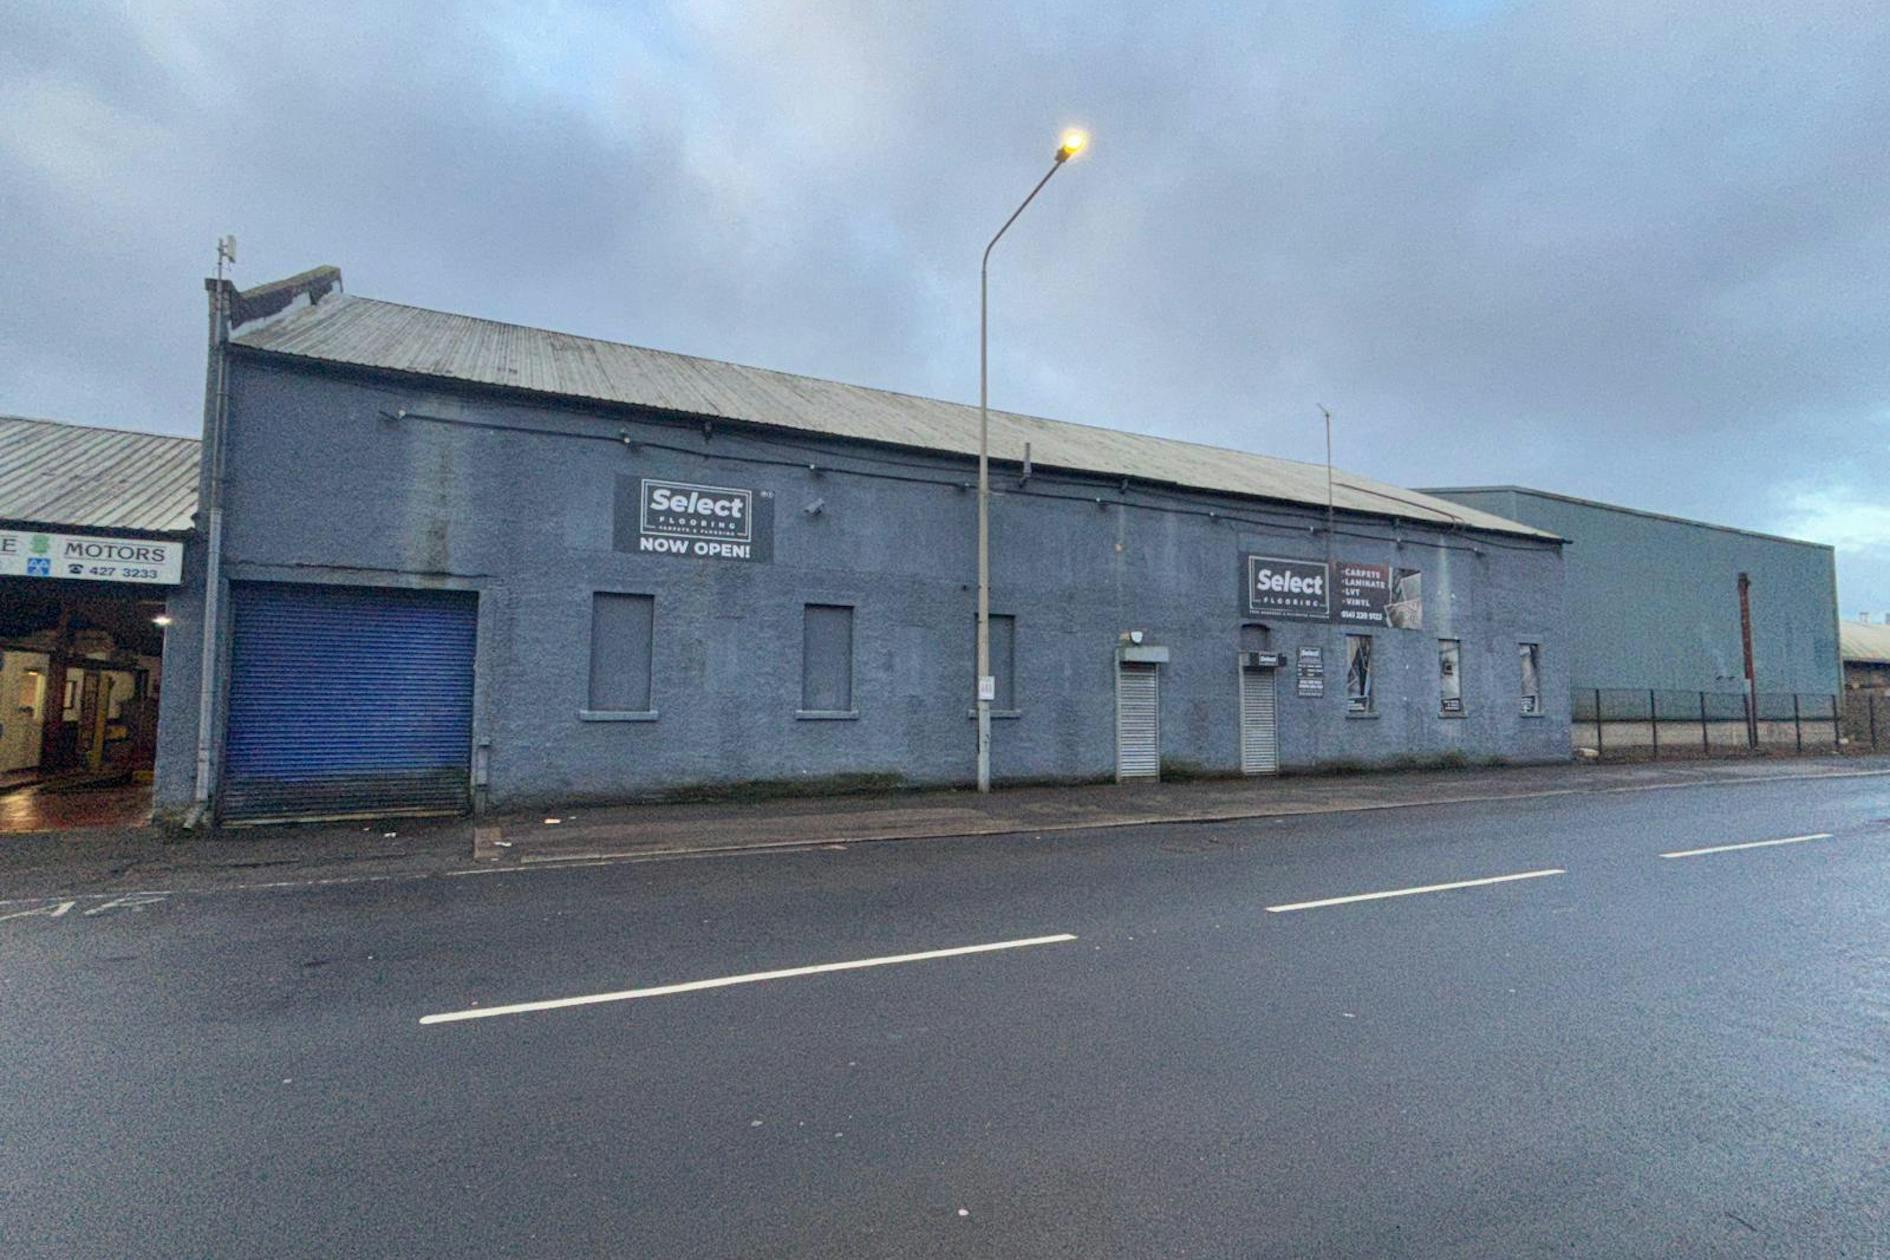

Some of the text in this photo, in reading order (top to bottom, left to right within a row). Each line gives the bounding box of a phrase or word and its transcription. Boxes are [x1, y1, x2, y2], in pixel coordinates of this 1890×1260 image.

[650, 488, 743, 518] Select
[659, 516, 736, 530] FLOORING
[64, 542, 166, 563] MOTORS
[640, 537, 751, 559] NOW OPEN!
[89, 567, 158, 579] 427 3233
[1344, 568, 1381, 579] CARPETS
[1257, 568, 1323, 595] Select
[1344, 578, 1386, 590] LAMINATE
[1345, 588, 1360, 597] LVT
[1346, 598, 1370, 608] VINYL
